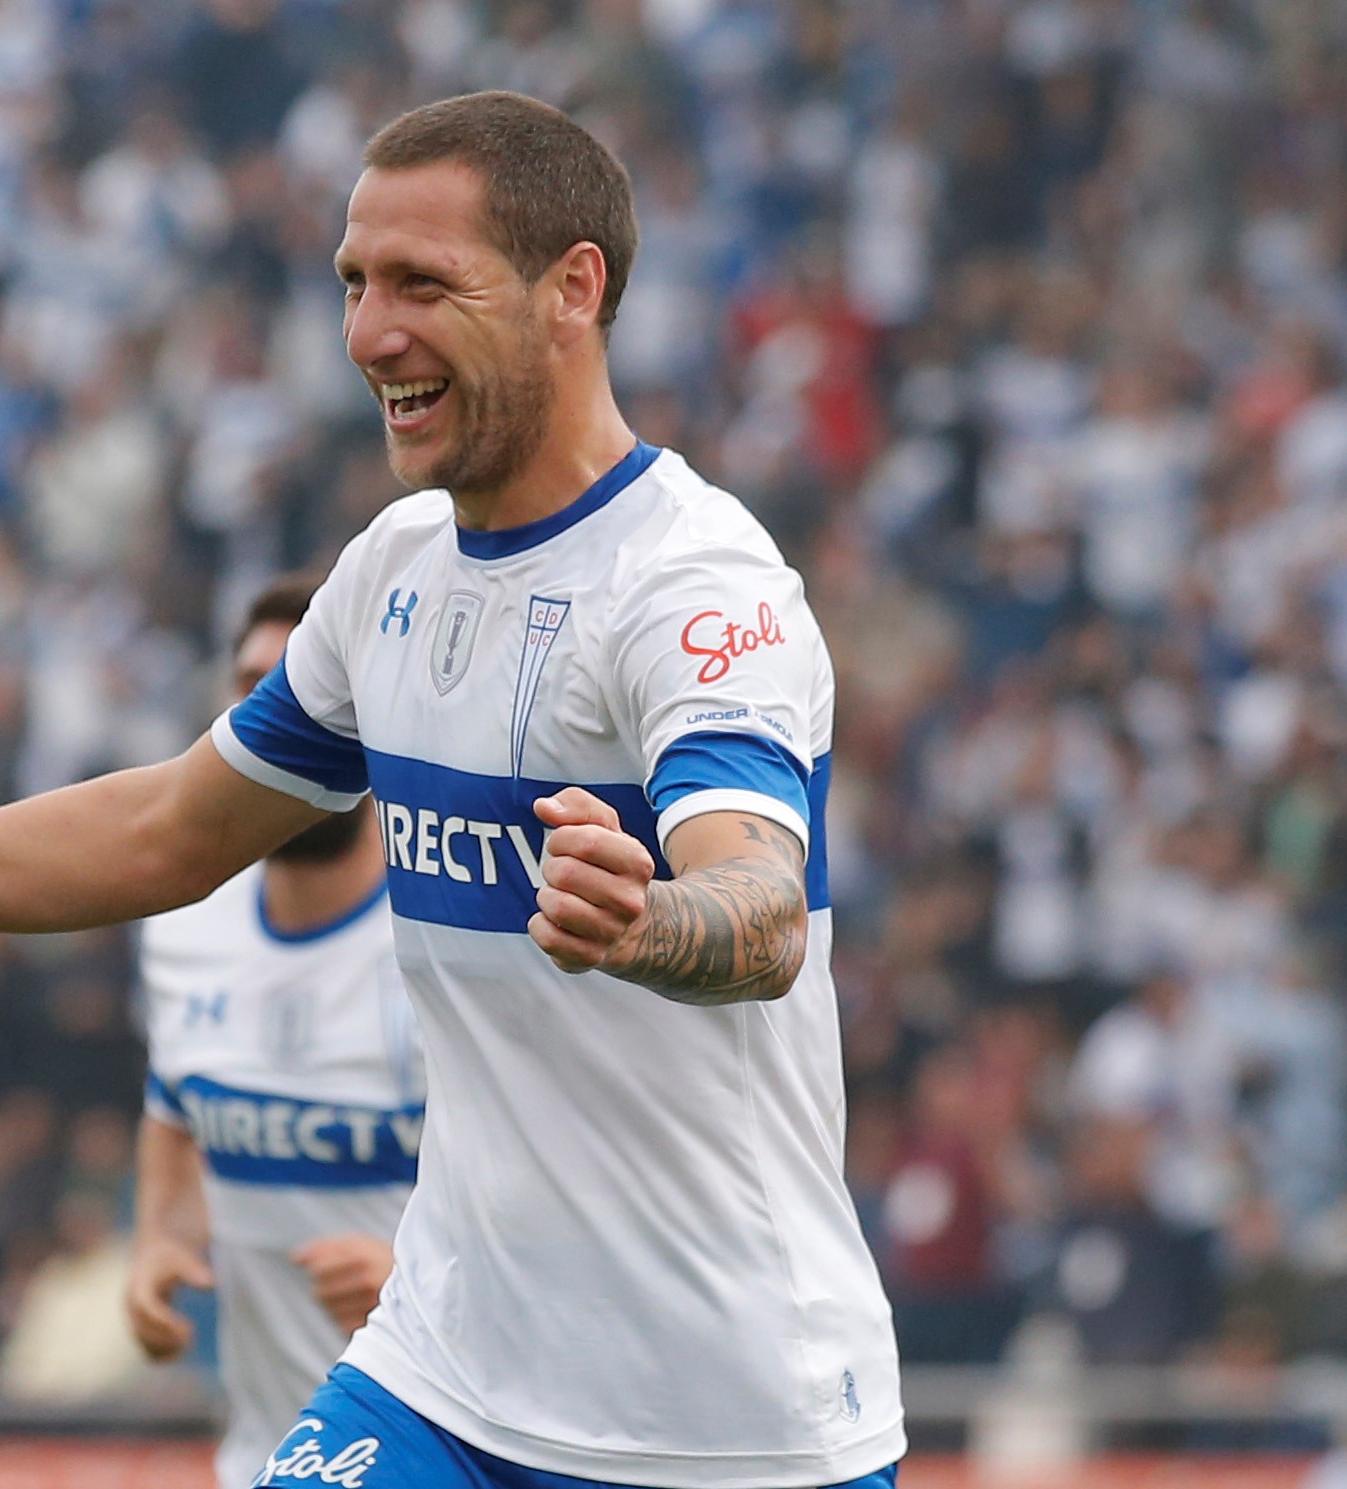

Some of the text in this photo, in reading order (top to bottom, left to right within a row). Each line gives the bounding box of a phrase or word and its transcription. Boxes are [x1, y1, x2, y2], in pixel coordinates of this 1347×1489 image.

[680, 600, 786, 684] Stoli
[686, 708, 748, 724] UNDER
[374, 800, 554, 889] IRECTV
[251, 1418, 380, 1489] Stoli
